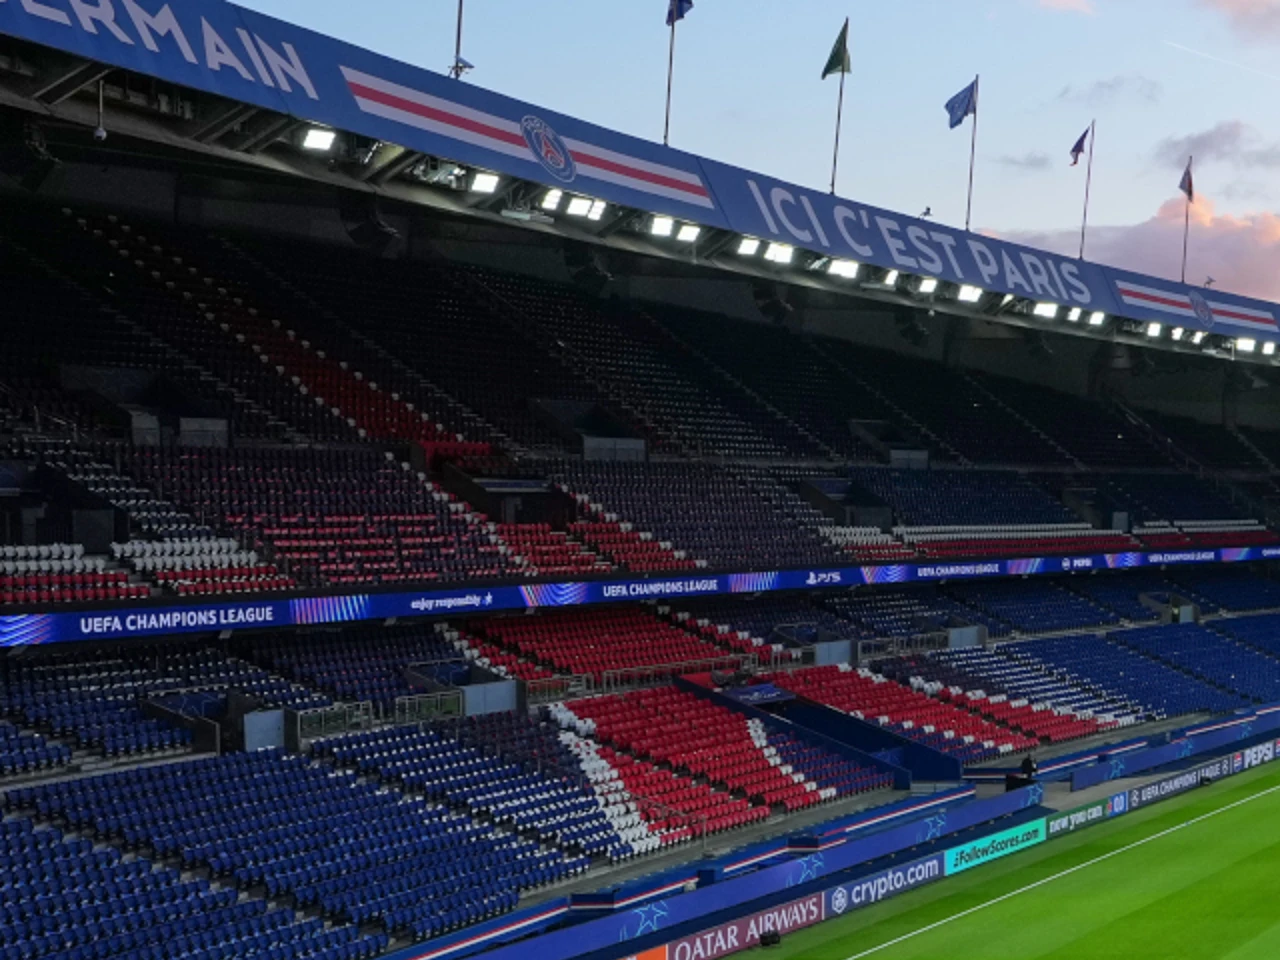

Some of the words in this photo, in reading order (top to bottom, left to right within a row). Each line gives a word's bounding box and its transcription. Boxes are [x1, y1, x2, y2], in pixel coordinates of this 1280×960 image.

[747, 179, 830, 247] ICI
[833, 205, 964, 279] C'EST
[967, 240, 1091, 303] PARIS
[602, 584, 628, 597] UEFA
[629, 581, 683, 595] CHAMPIONS
[684, 579, 718, 593] LEAGUE
[80, 616, 121, 634] UEFA
[125, 609, 216, 631] CHAMPIONS
[218, 606, 273, 623] LEAGUE
[1244, 742, 1274, 769] PEPSI
[851, 857, 939, 903] crypto.com
[746, 897, 818, 943] AIRWAYS
